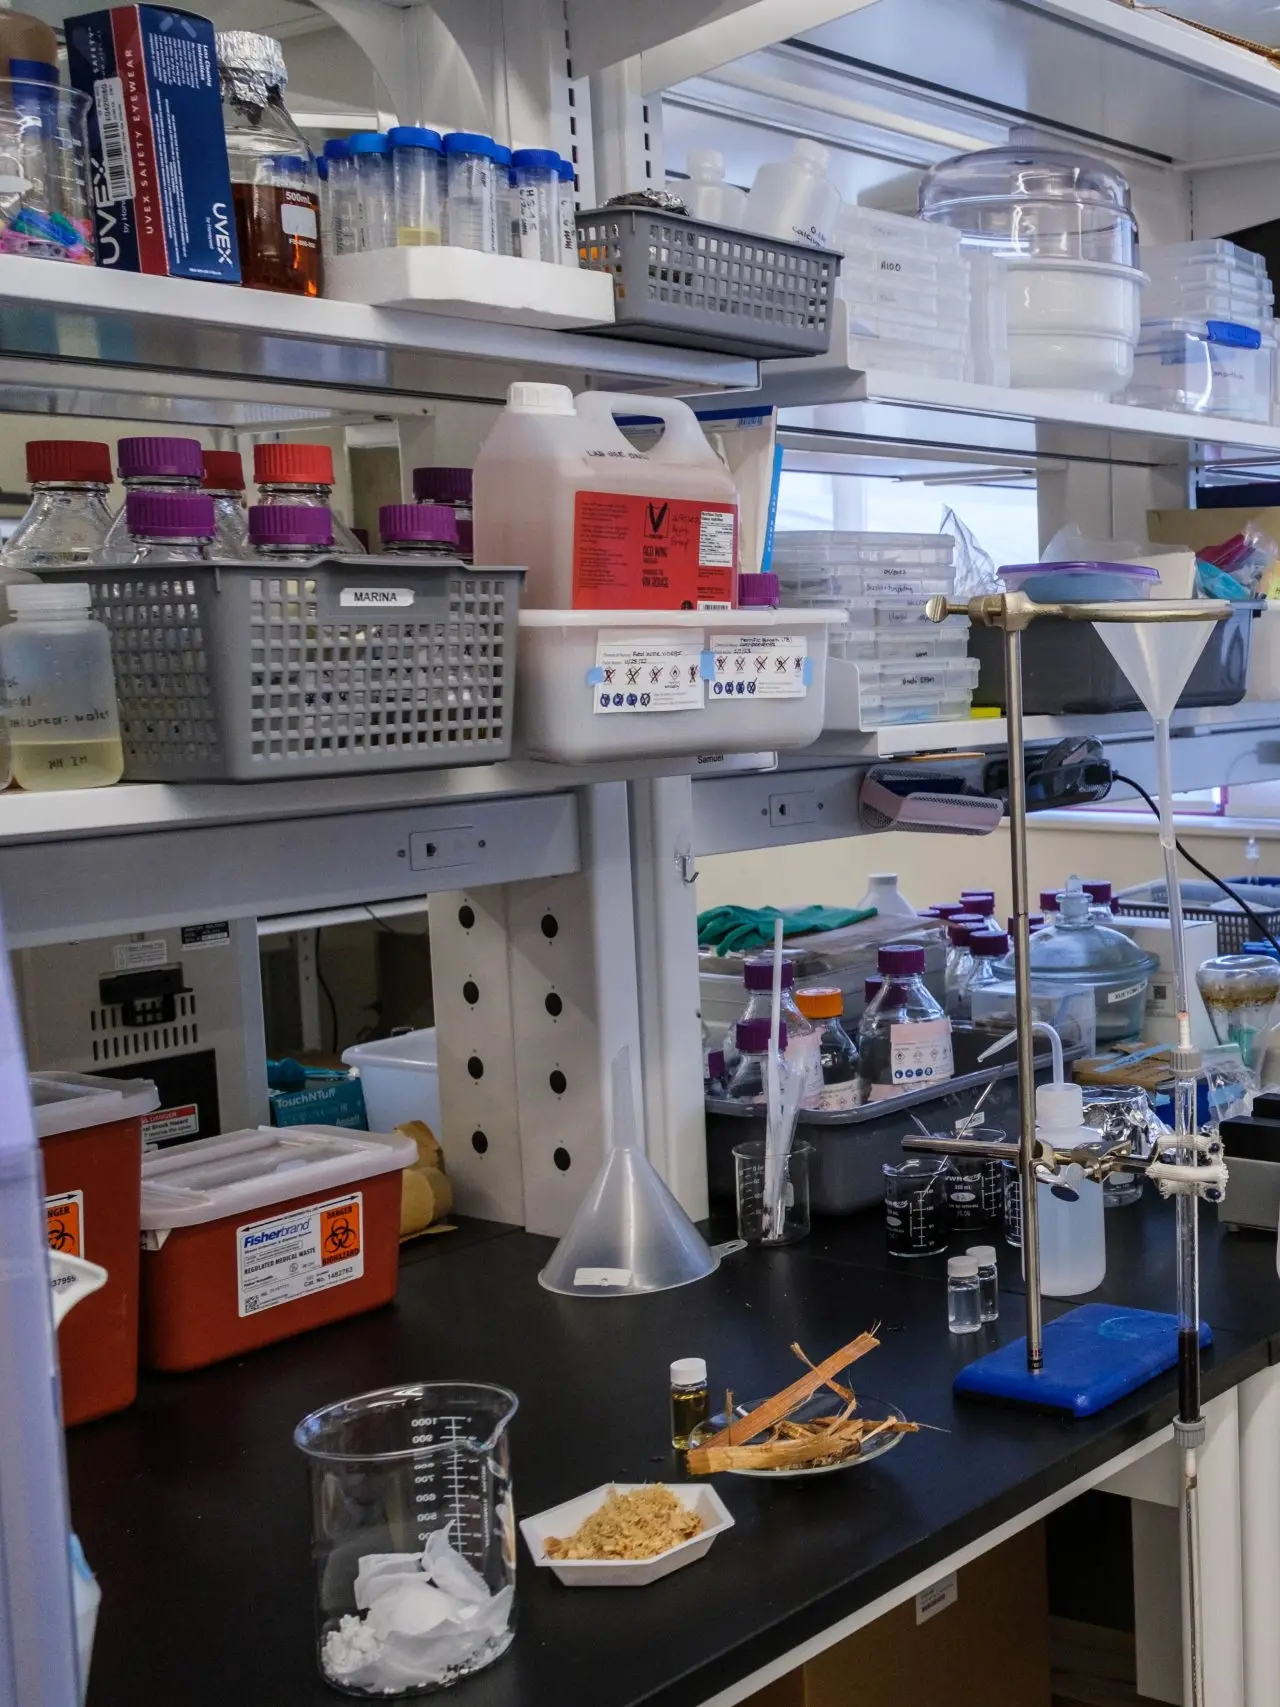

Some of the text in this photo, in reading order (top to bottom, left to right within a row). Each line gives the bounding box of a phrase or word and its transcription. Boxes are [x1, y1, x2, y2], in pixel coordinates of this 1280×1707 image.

[125, 49, 155, 235] UVEX SAFETY EYEWEAR
[212, 202, 234, 266] UVEX
[354, 592, 398, 602] MARINA
[697, 753, 724, 765] Samuel
[275, 1088, 337, 1109] TouchNTuff
[48, 1206, 70, 1218] NGER
[326, 1206, 353, 1219] DANGER
[243, 1219, 310, 1249] Fisherbrand
[244, 1260, 275, 1275] REGULATED
[275, 1253, 298, 1265] MEDICAL
[298, 1247, 316, 1257] WASTE
[322, 1248, 359, 1267] BIOHAZARD
